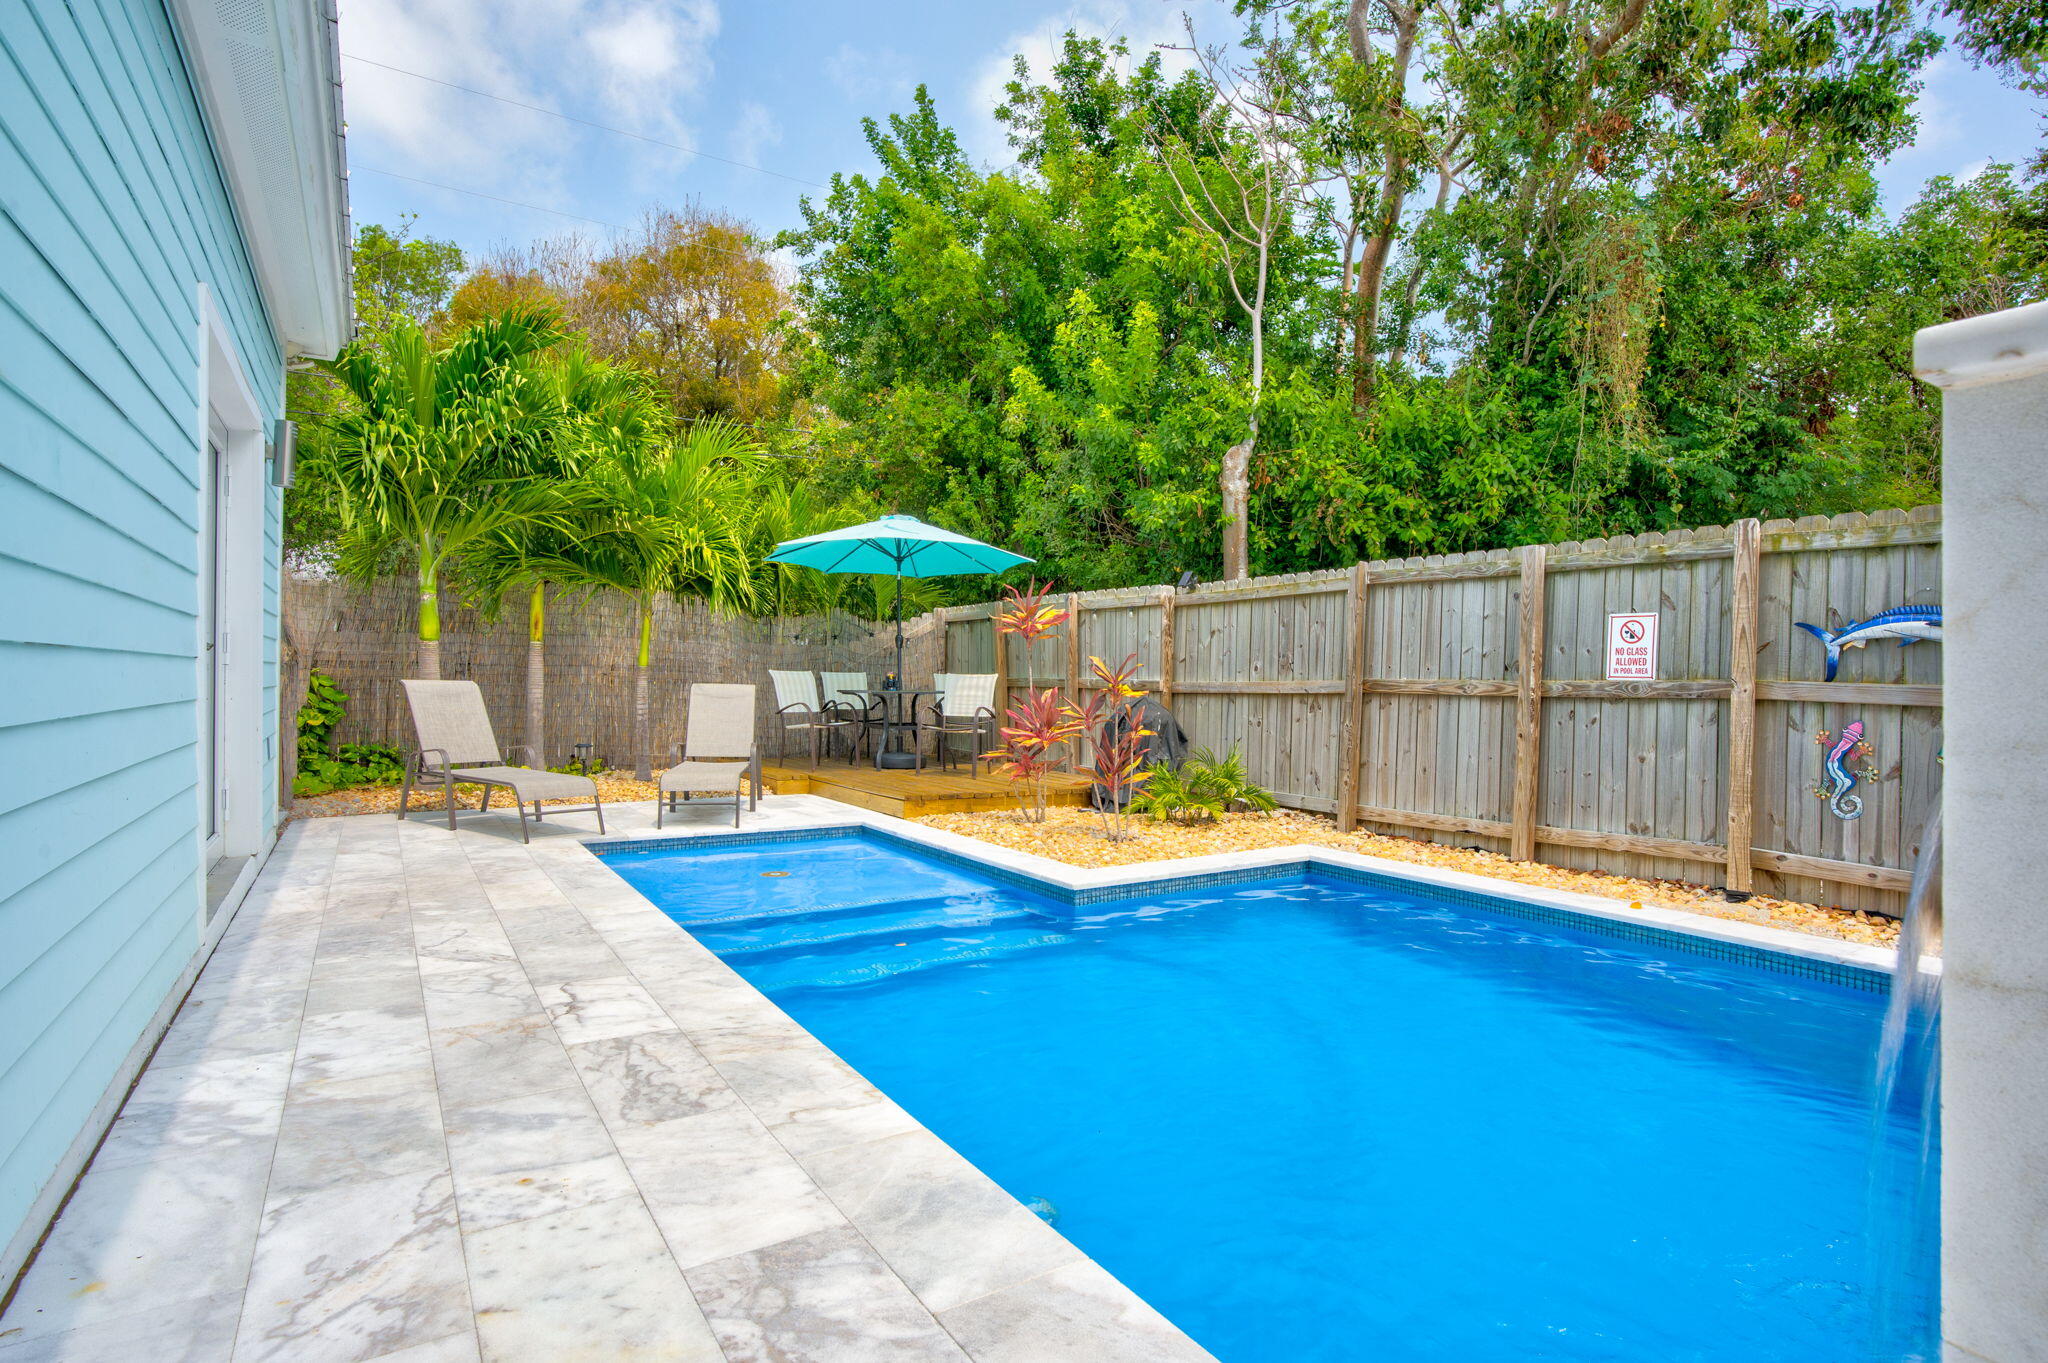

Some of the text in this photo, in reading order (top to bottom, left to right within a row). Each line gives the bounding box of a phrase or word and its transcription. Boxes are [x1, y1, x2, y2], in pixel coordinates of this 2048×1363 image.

[1615, 647, 1648, 656] NO GLASS
[1616, 658, 1647, 666] ALLOWED
